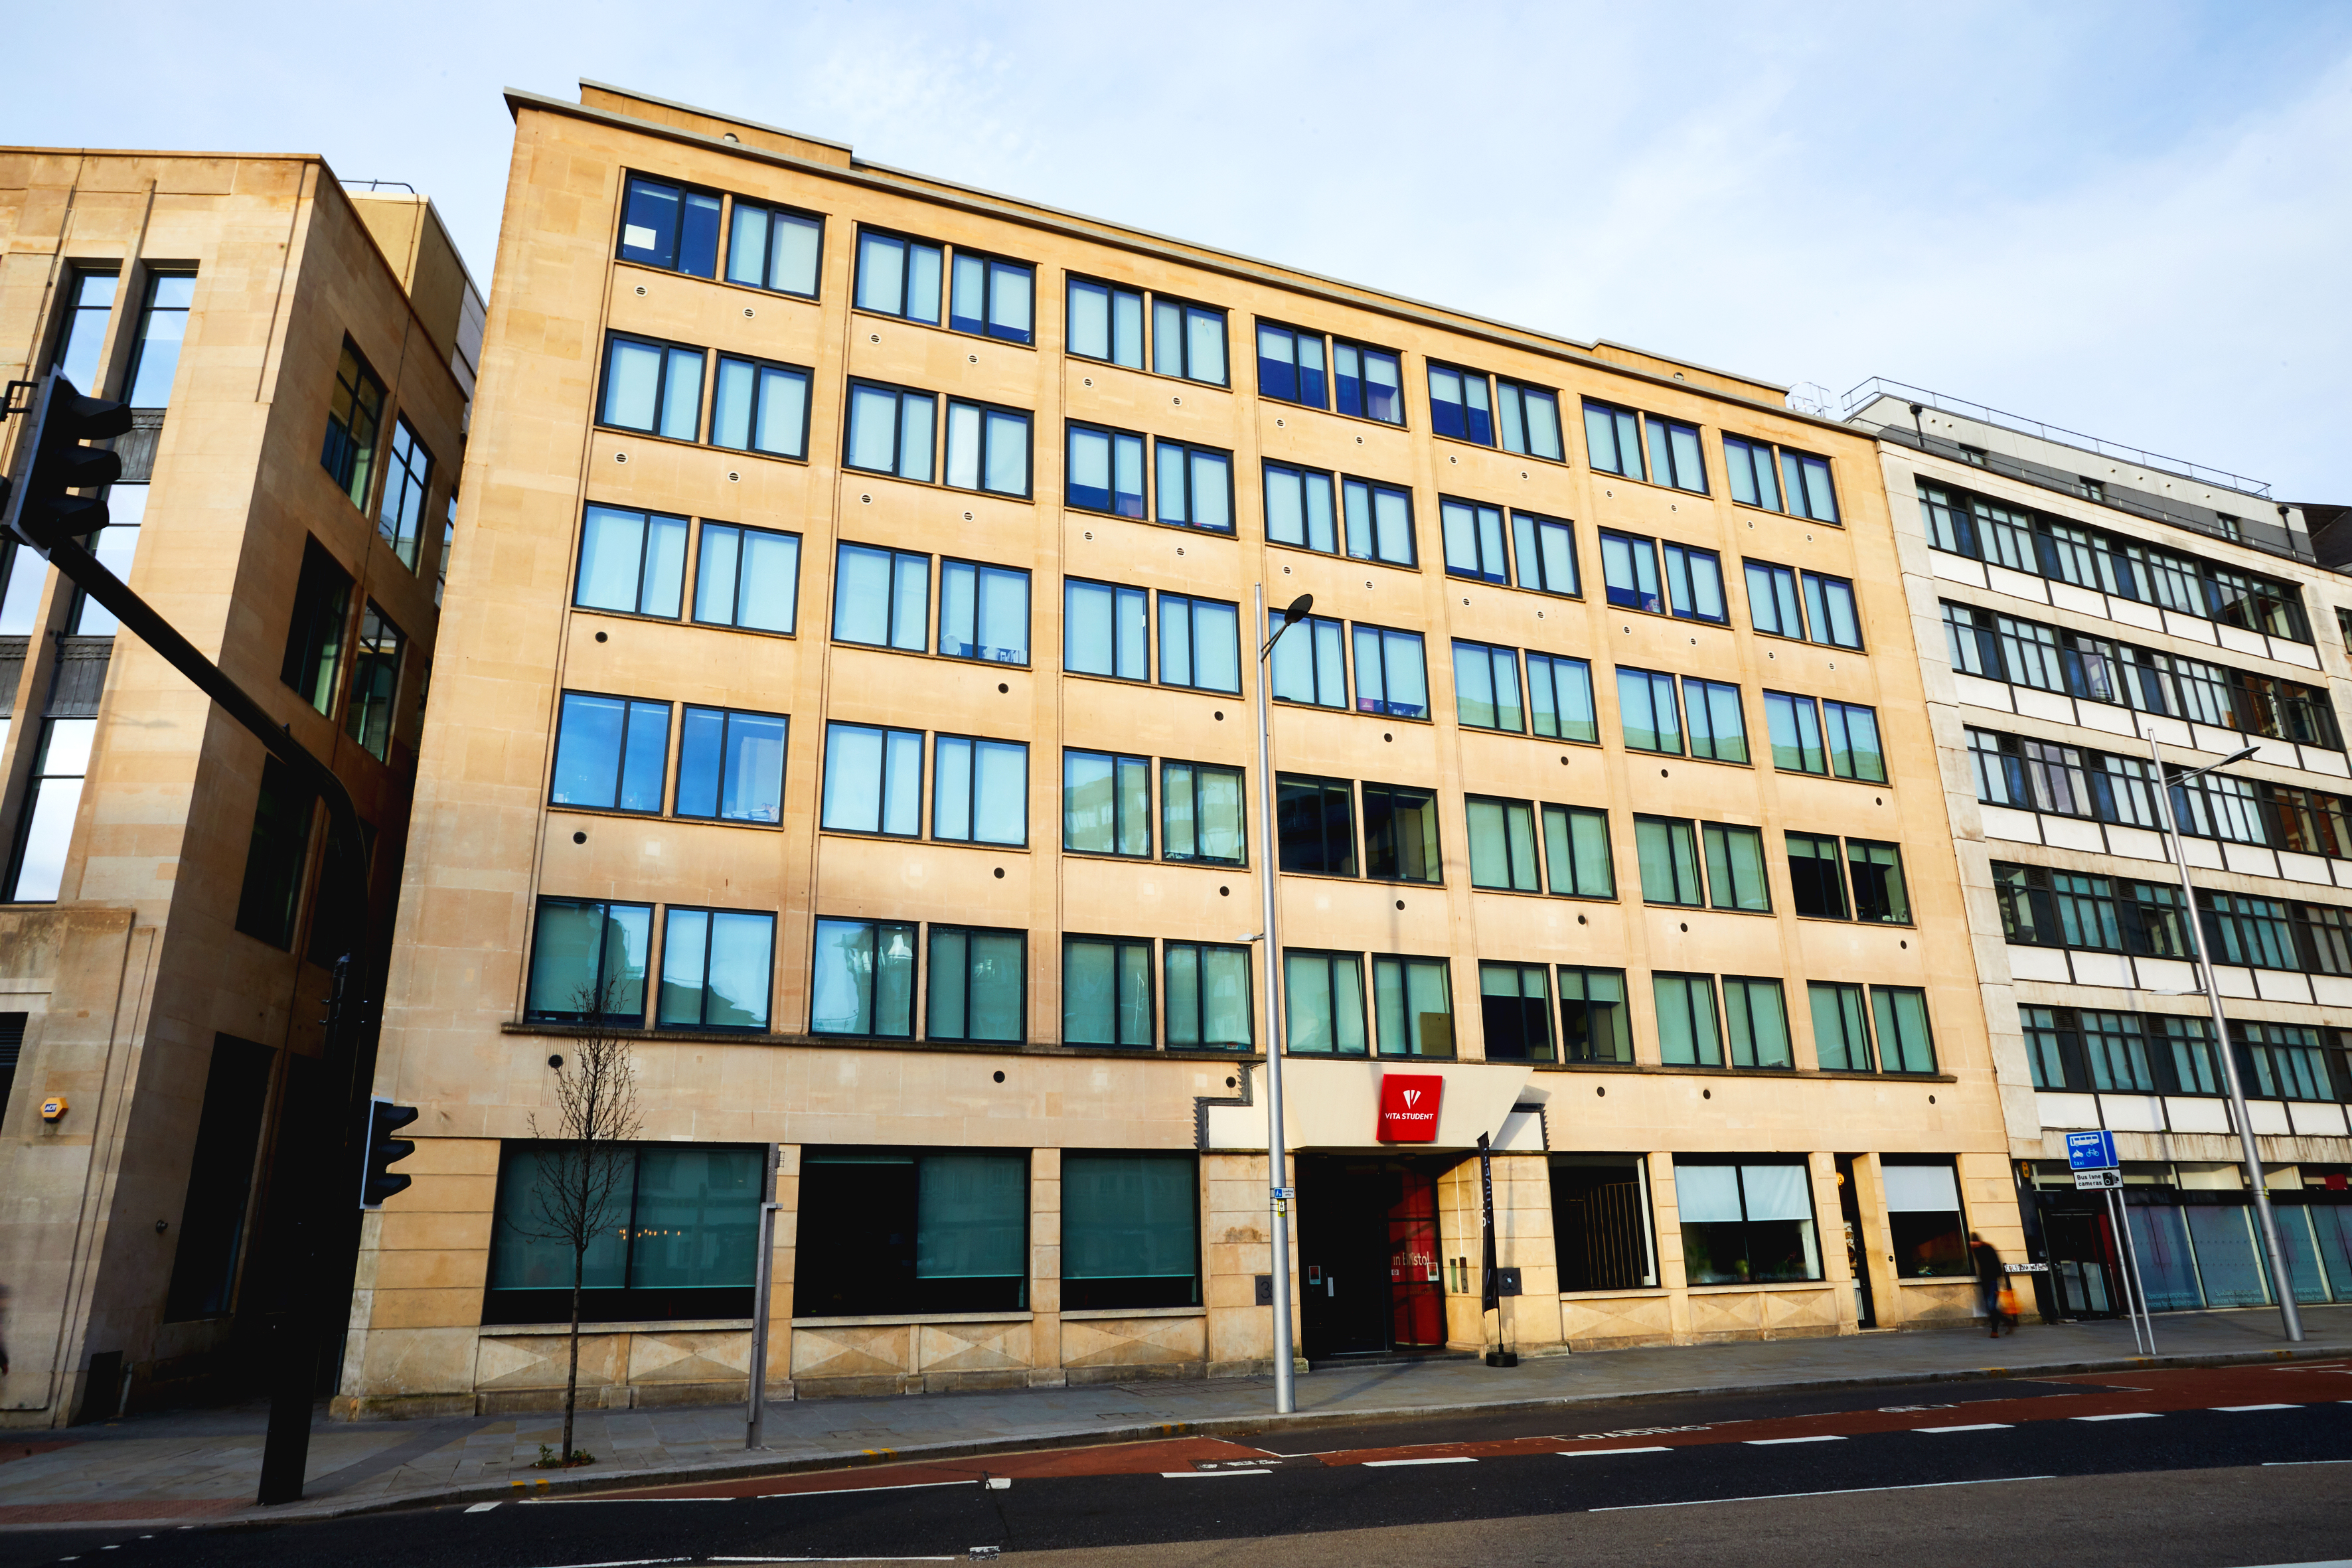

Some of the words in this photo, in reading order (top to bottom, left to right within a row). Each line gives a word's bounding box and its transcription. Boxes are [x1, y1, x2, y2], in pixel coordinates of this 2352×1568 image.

[1393, 1253, 1401, 1266] in
[1402, 1251, 1430, 1266] Bristol
[1261, 1281, 1273, 1299] 3
[1551, 1425, 1713, 1441] LOADING
